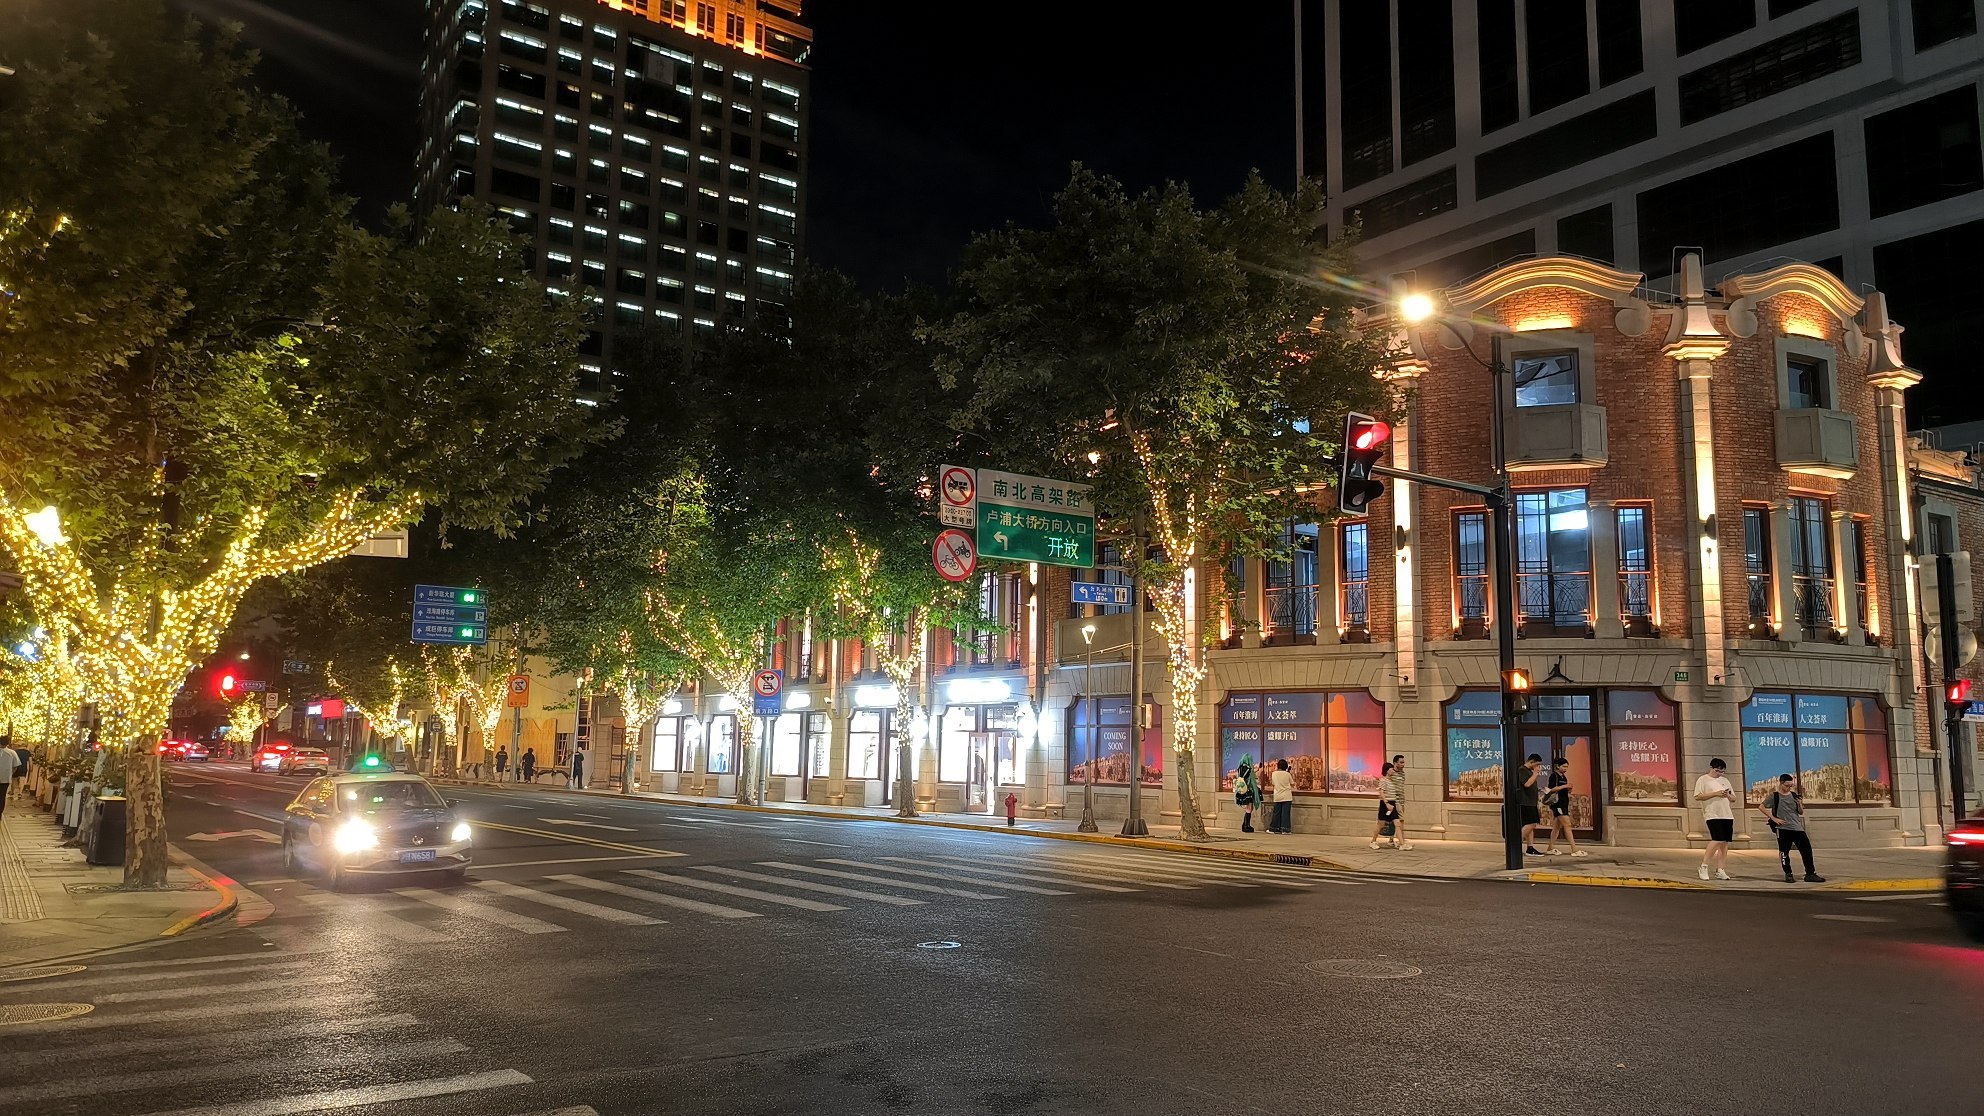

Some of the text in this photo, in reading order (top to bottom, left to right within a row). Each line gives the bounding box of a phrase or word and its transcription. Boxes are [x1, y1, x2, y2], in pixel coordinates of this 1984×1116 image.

[993, 479, 1081, 508] 南北高架路
[986, 509, 1087, 535] 卢浦大桥方向入口
[1048, 536, 1080, 560] 开放
[1757, 712, 1827, 725] 百年淮海 人文荟萃
[1103, 732, 1127, 740] COMING
[1107, 742, 1124, 751] SOON
[1454, 739, 1491, 749] 百年淮海
[1465, 750, 1502, 760] 人文荟萃
